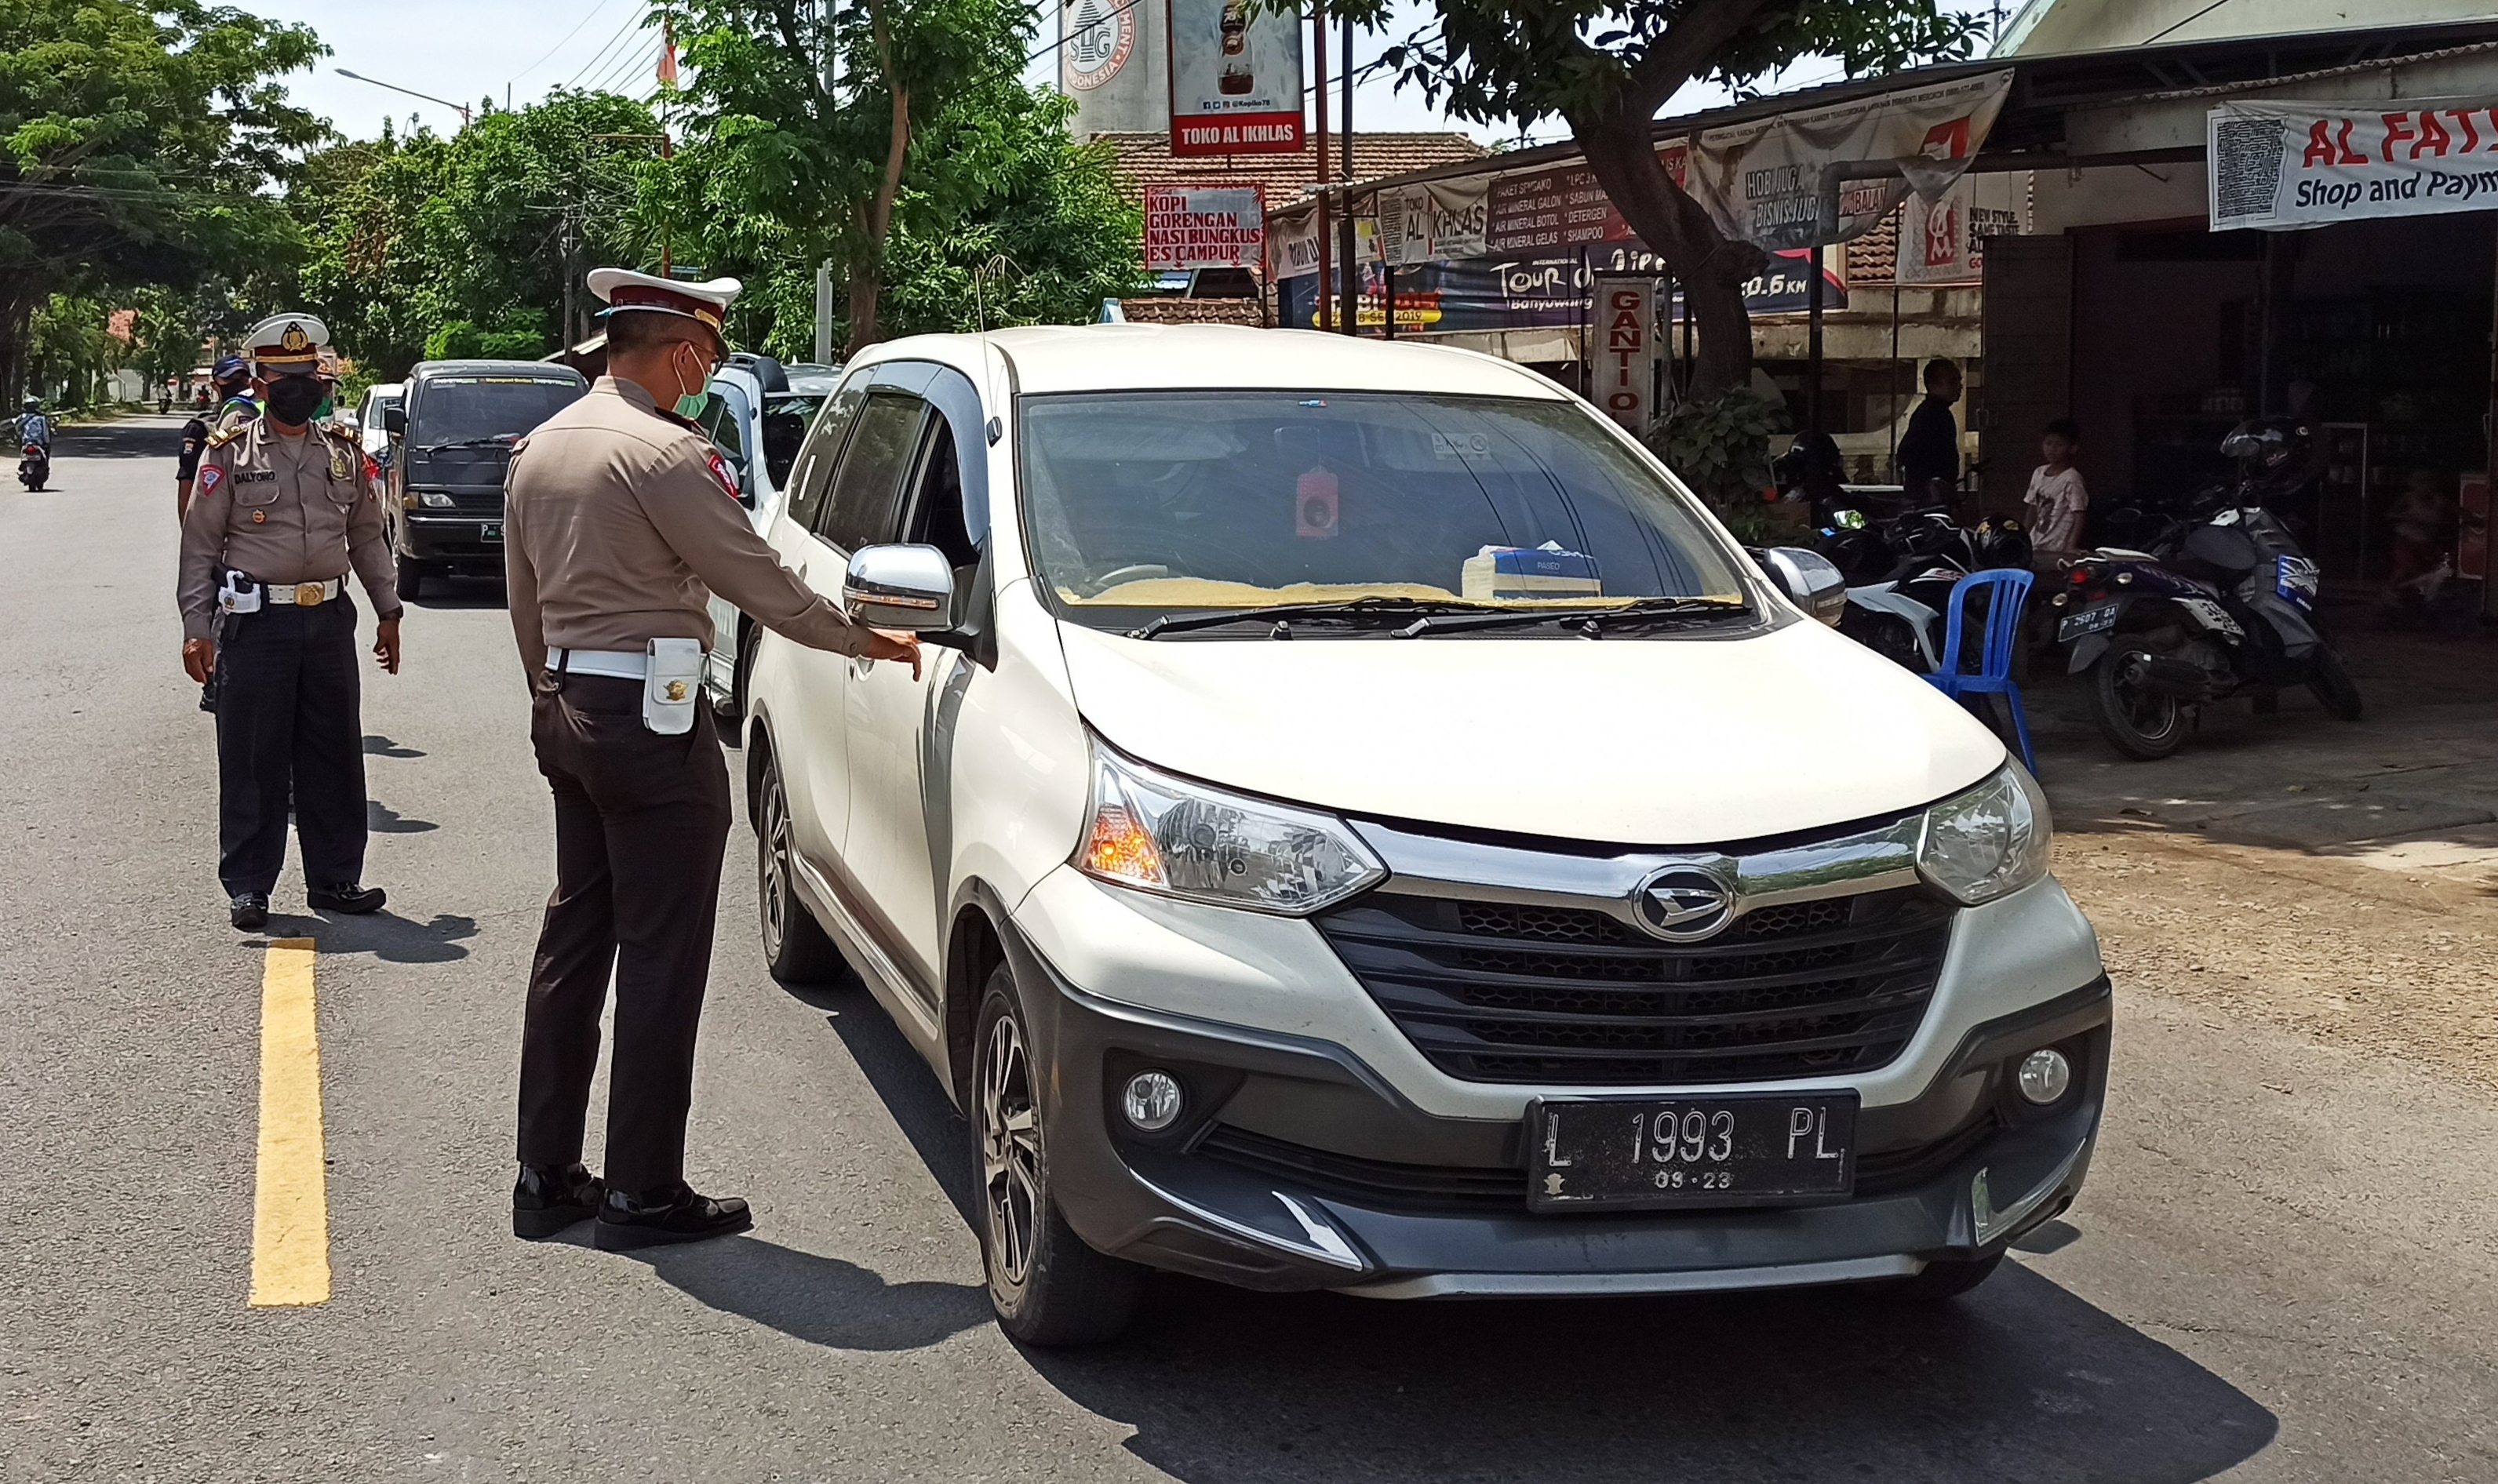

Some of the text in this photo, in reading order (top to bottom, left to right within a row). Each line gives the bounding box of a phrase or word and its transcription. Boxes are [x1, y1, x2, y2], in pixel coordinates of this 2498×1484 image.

[1182, 124, 1294, 145] TOKO AL IKHLAS
[2302, 107, 2498, 169] AL FAT
[1569, 191, 1593, 206] SABUN
[2296, 178, 2362, 209] Shop
[2369, 171, 2422, 202] and
[1149, 196, 1187, 213] KOPI
[1404, 198, 1424, 212] TOKO
[1495, 204, 1507, 216] AIR
[1538, 195, 1561, 210] GALON
[1149, 212, 1237, 228] GORENGAN
[1495, 222, 1506, 233] AIR
[1536, 213, 1560, 227] BOTOL
[1568, 207, 1607, 224] DETERGEN
[1969, 207, 1990, 223] NEW
[1406, 213, 1425, 242] AL
[1568, 226, 1604, 242] SHAMPOO
[1149, 228, 1261, 245] NASI BUNGKUS
[1535, 231, 1558, 246] GELAS
[1150, 245, 1240, 262] ES CAMPUR
[1785, 279, 1808, 295] KM
[235, 471, 276, 484] DALYONO
[1537, 561, 1560, 571] PASEO
[1549, 1106, 1840, 1167] L 1993 PL
